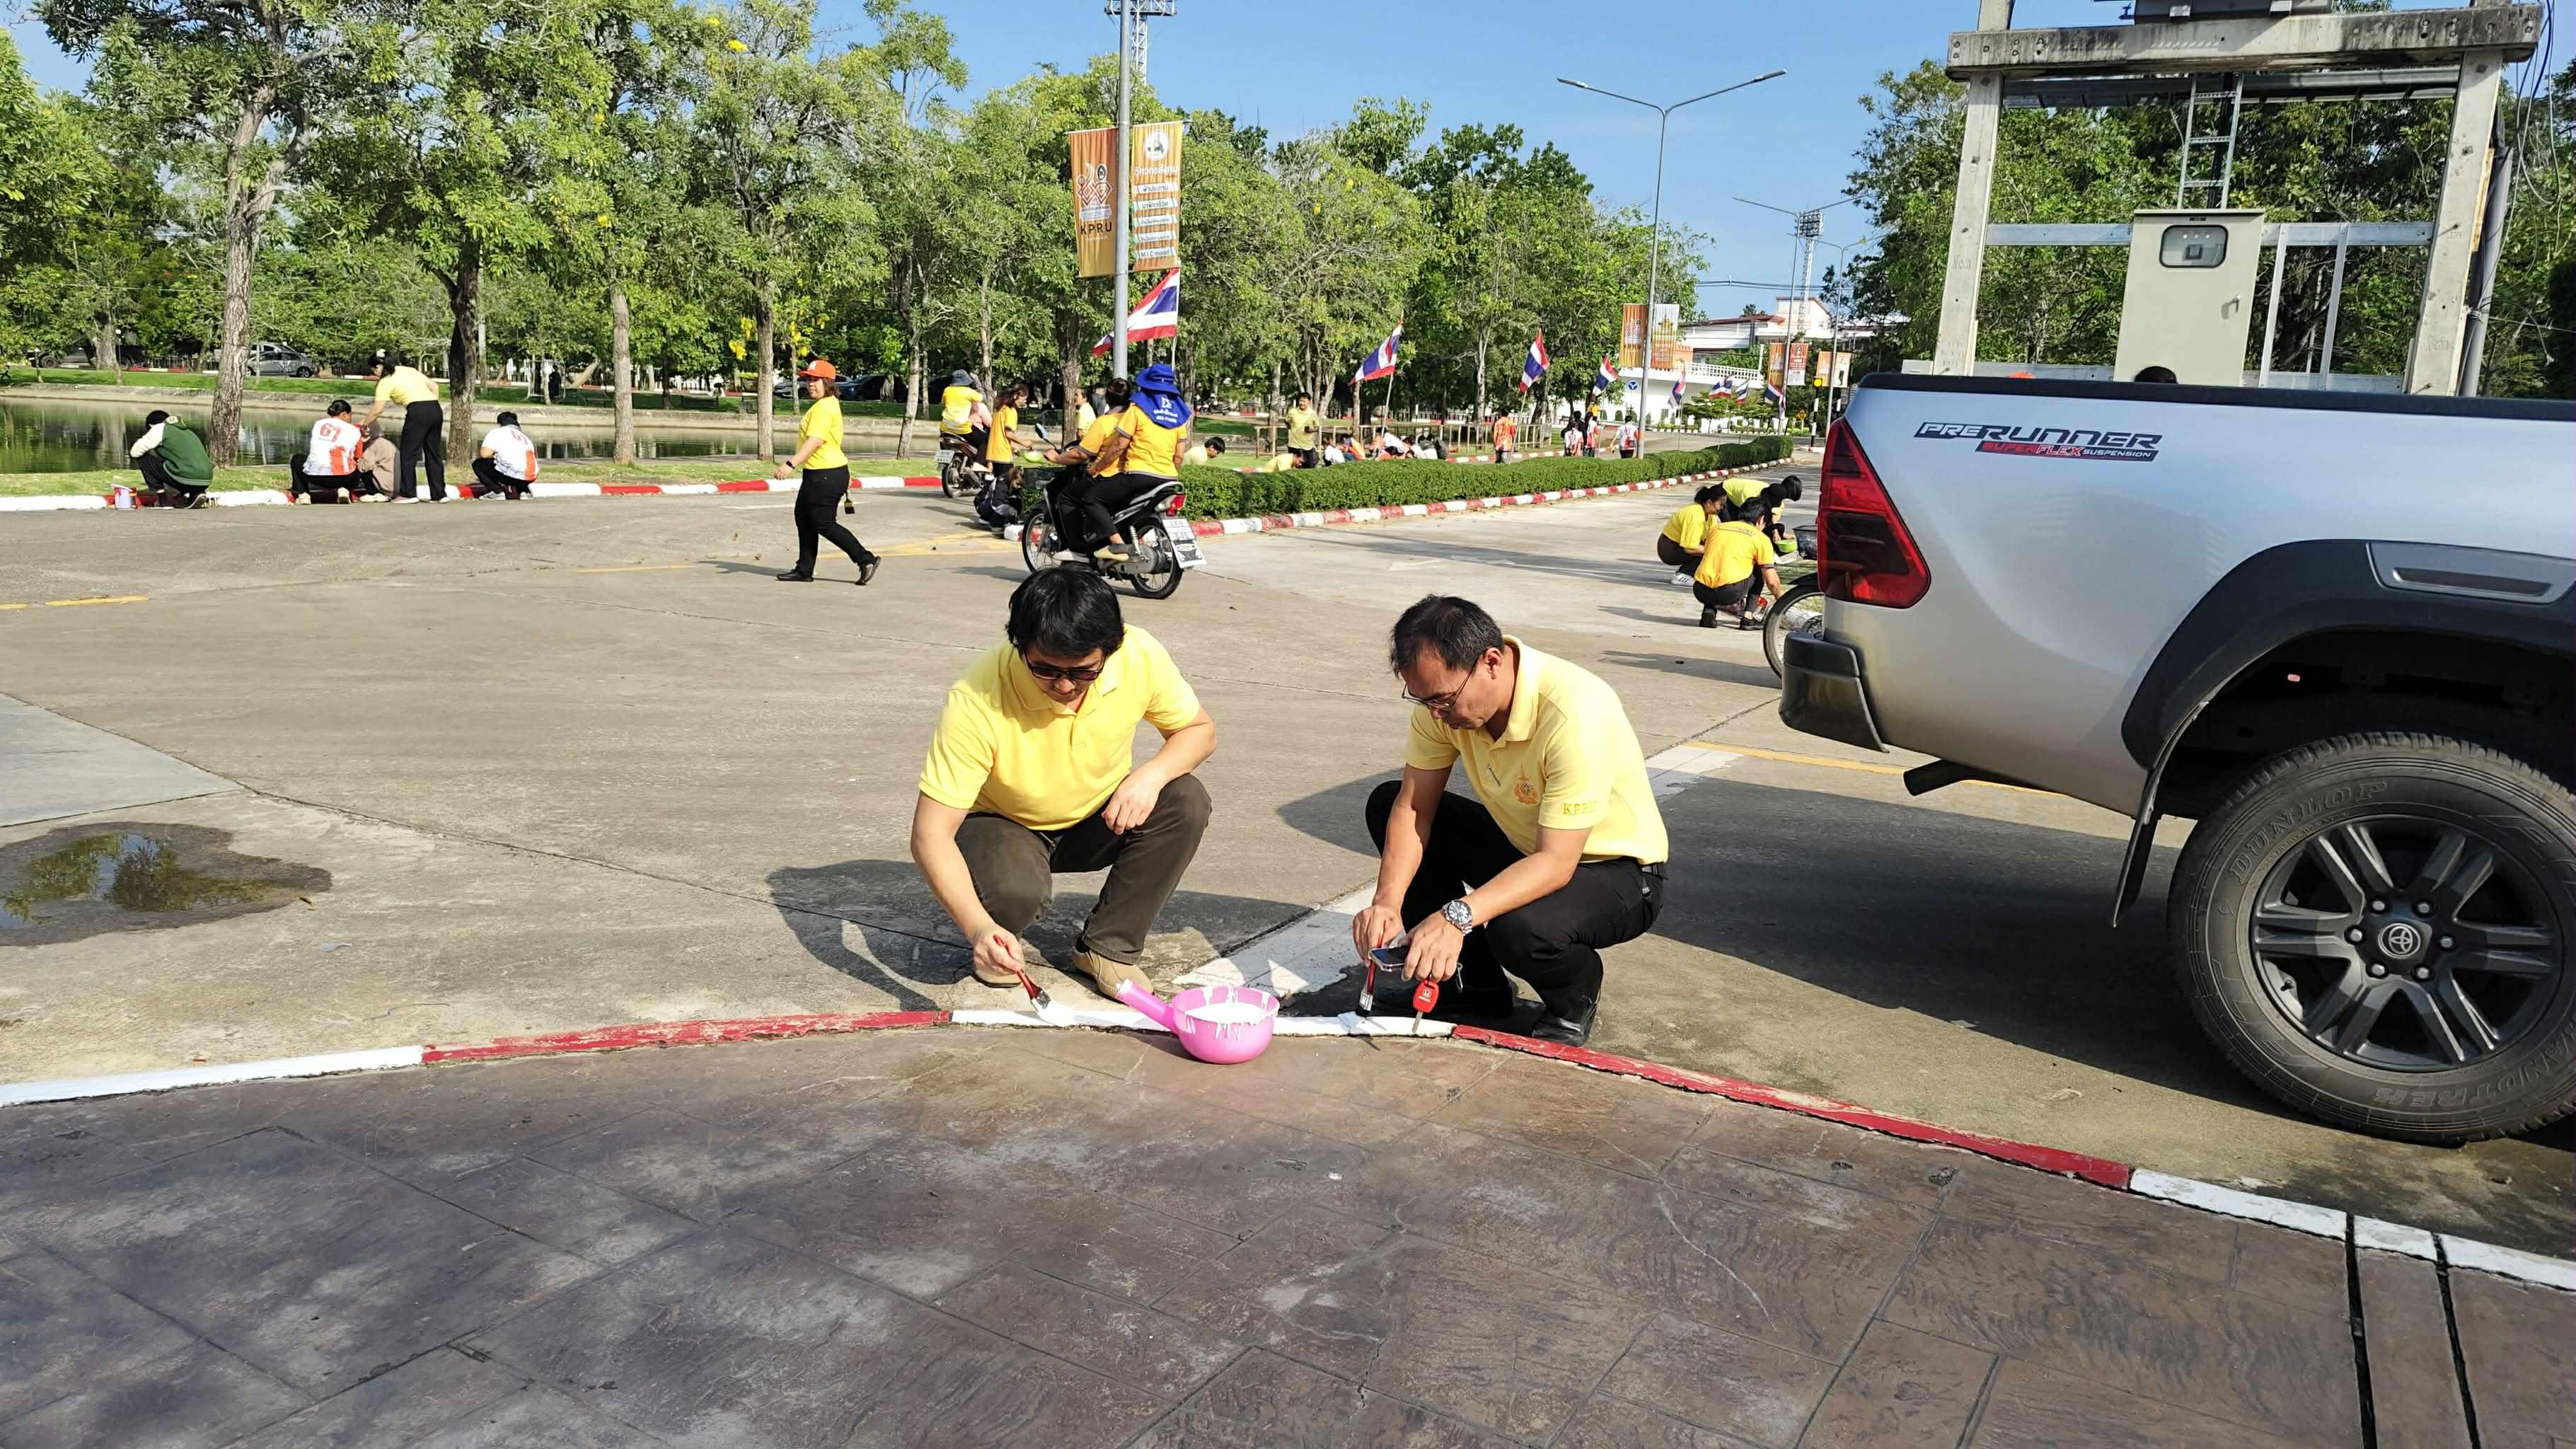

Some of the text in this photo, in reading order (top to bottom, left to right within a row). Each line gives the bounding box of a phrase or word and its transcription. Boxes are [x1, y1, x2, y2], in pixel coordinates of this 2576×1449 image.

[1080, 221, 1112, 235] KPRU
[320, 423, 341, 442] 67
[1914, 422, 2162, 449] PRERUNNER
[2082, 448, 2152, 458] SUSPENSION
[2229, 781, 2387, 884] DUNLOP
